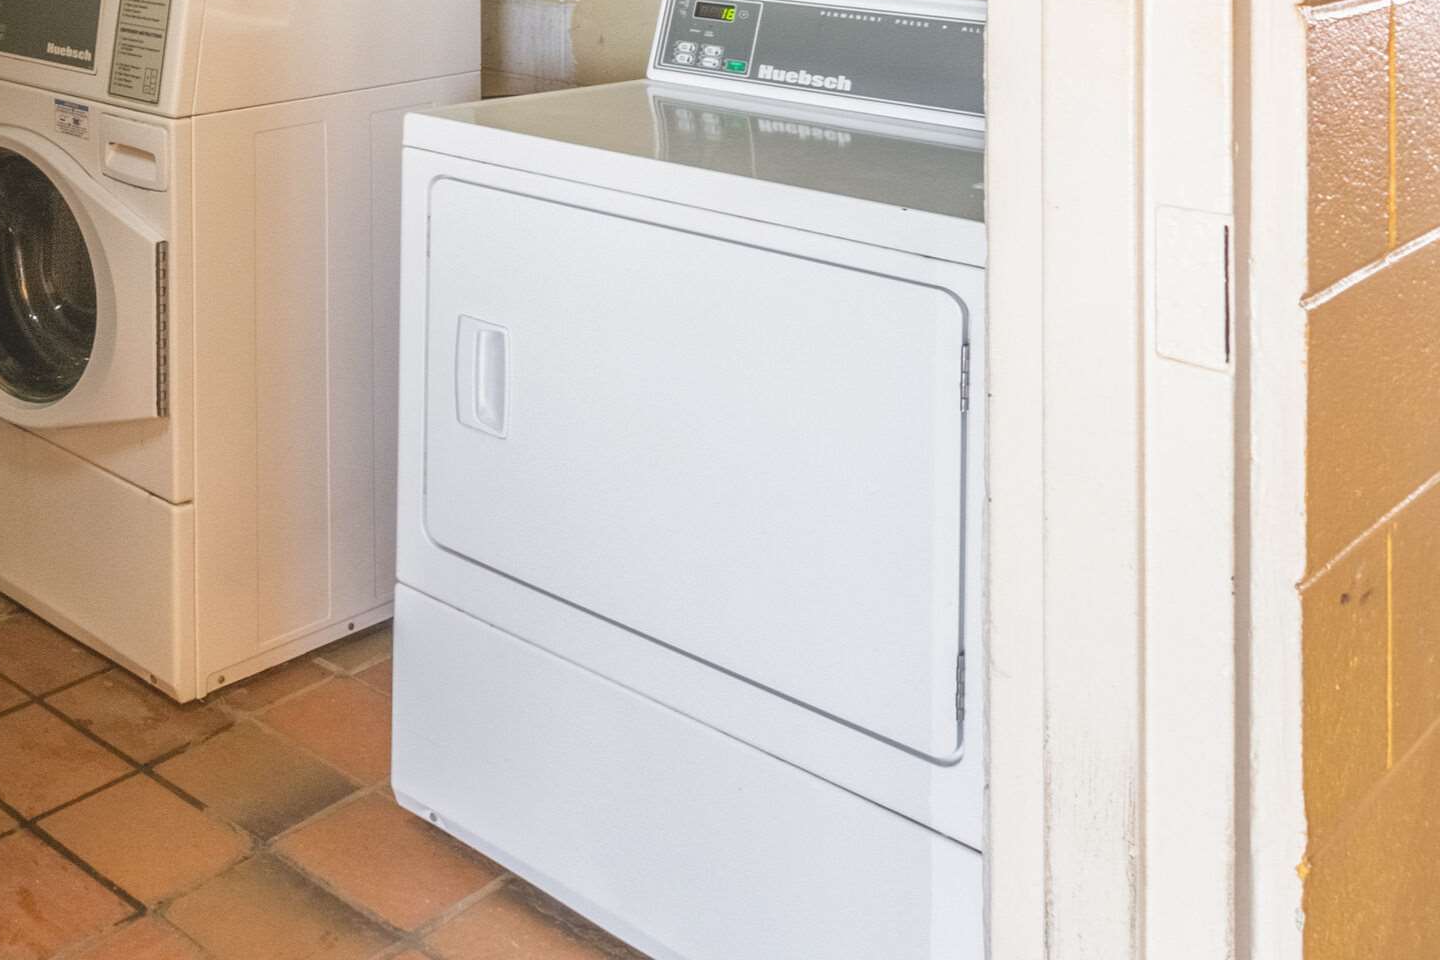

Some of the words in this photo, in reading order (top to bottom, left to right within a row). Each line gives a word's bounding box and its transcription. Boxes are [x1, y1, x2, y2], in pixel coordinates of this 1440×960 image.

[721, 8, 736, 20] 18
[895, 18, 930, 28] PRESS
[47, 41, 92, 61] Huebsch
[758, 64, 852, 91] Huebsch
